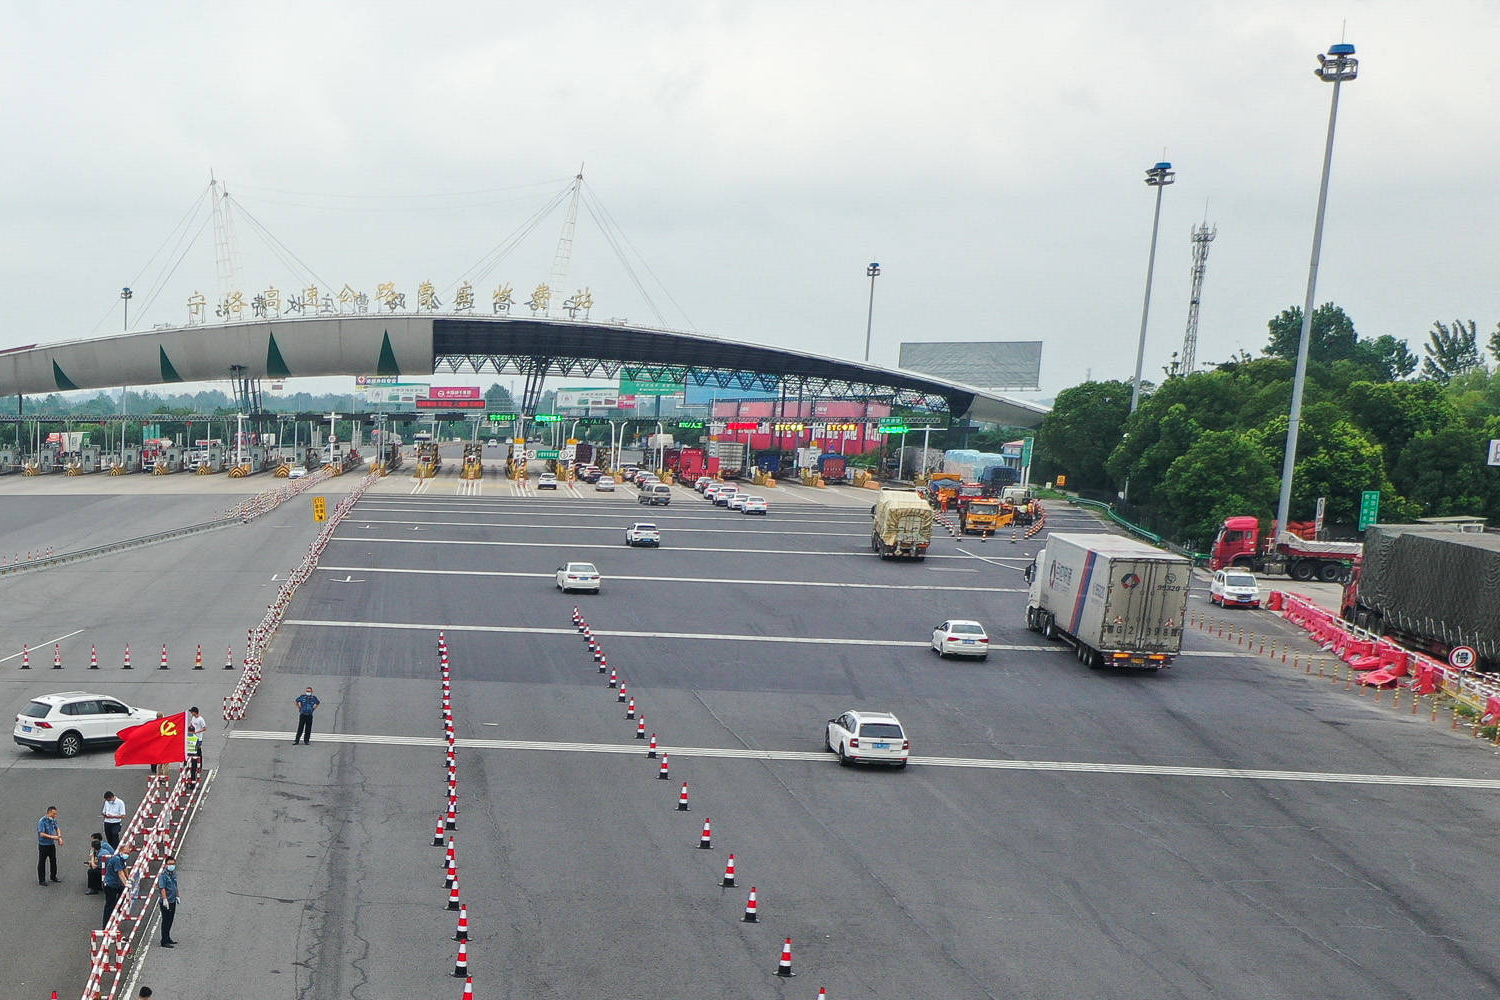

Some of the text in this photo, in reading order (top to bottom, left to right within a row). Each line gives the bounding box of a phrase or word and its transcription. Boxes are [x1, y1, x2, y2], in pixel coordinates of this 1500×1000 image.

[188, 280, 594, 314] 宁洛高速公路曹庄收费站
[1455, 652, 1469, 664] 慢
